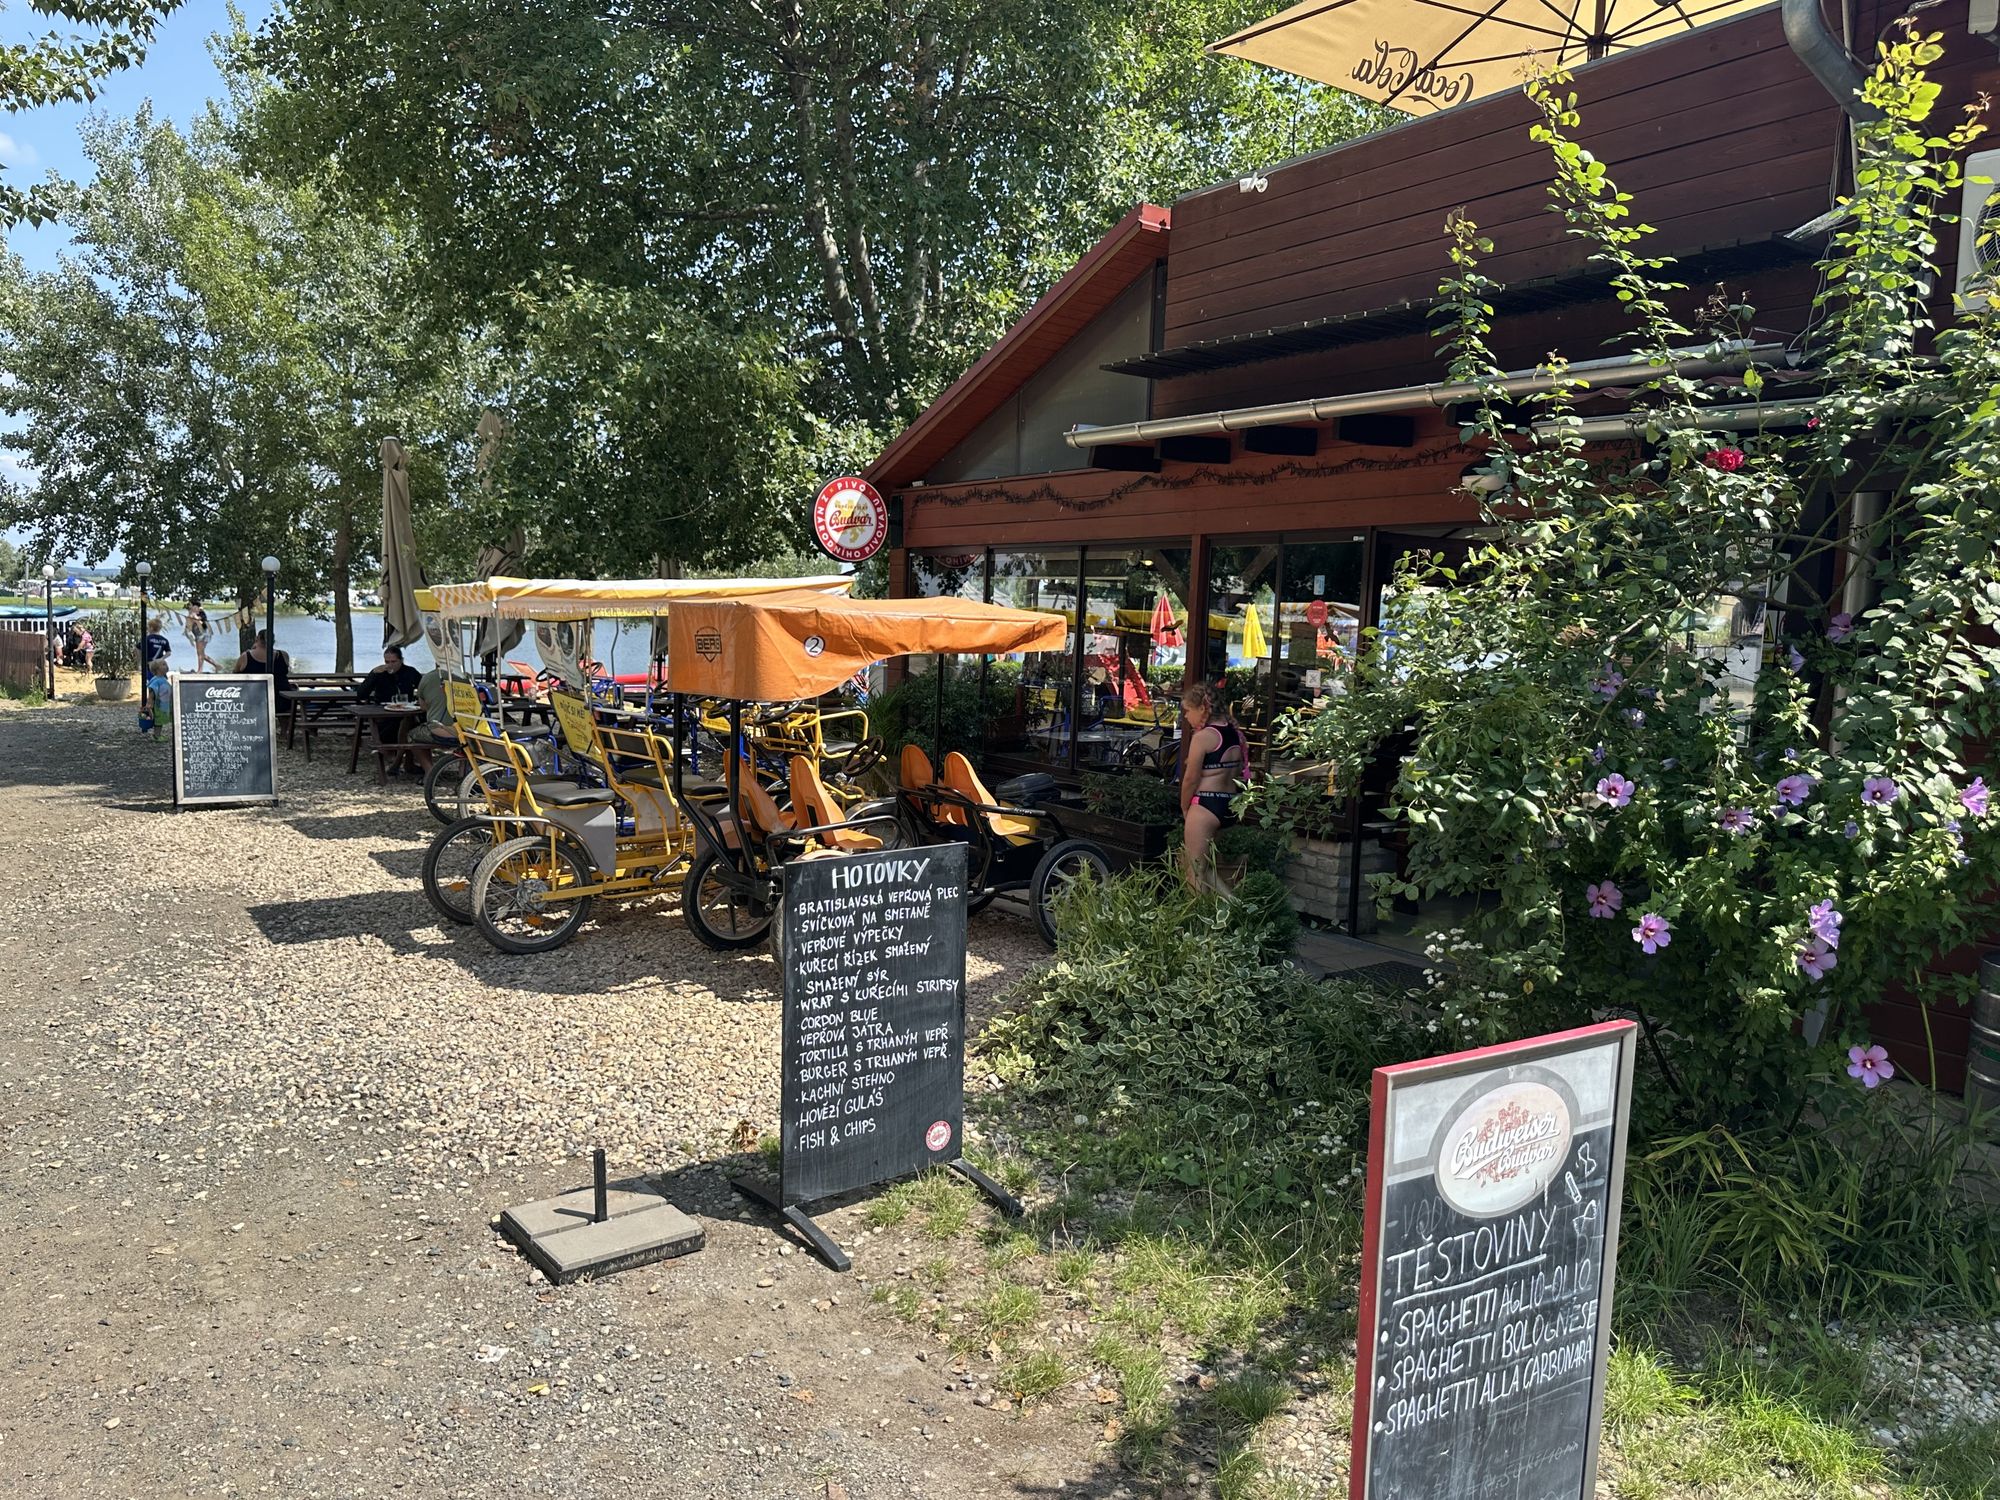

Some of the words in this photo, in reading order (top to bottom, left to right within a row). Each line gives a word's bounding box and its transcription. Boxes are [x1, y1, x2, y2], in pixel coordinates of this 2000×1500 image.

[837, 481, 866, 492] PIVO
[817, 506, 861, 558] NÁRODNÍHO
[864, 498, 884, 553] PIVOVARU
[829, 510, 873, 530] Budvar
[153, 644, 162, 660] 7
[809, 637, 819, 653] 2
[205, 687, 242, 698] Coca-Cola
[832, 858, 930, 889] HOTOVKY
[800, 889, 883, 915] BRATISLAVSKÁ
[889, 884, 932, 903] VEPŘOVÁ
[937, 887, 959, 900] PLEC
[802, 912, 855, 933] SVÍČKOVÁ
[863, 912, 876, 926] NA
[800, 950, 838, 975] KUŘECÍ
[844, 949, 877, 967] ŘÍZEK
[885, 935, 932, 959] SMAŽENÝ
[802, 931, 846, 955] VEPŘOVÉ
[854, 925, 903, 945] VÝPEČKY
[801, 995, 833, 1010] WRAP
[840, 992, 849, 1003] S
[855, 980, 908, 1001] KUŘECÍMI
[916, 979, 959, 997] STRIPSY
[806, 970, 861, 994] SMAŽENÝ
[867, 968, 889, 982] SÝR
[801, 1012, 843, 1030] CORDON
[850, 1008, 878, 1022] BLUE
[801, 1026, 846, 1046] VEPŘOVÁ
[852, 1020, 893, 1038] JÁTRA
[800, 1045, 848, 1064] TORTILLA
[856, 1042, 863, 1052] S
[867, 1029, 917, 1050] TRHANÝM
[800, 1062, 848, 1082] BURGER
[854, 1060, 861, 1072] S
[865, 1048, 917, 1069] TRHANÝM
[923, 1043, 951, 1060] VEPŘ.
[801, 1078, 846, 1103] KACHNÍ
[852, 1071, 894, 1090] STEHNO
[800, 1098, 840, 1128] HOVĚZÍ
[845, 1087, 884, 1115] GULÁŠ
[800, 1130, 824, 1152] FISH
[830, 1126, 840, 1145] &
[845, 1118, 876, 1136] CHIPS
[1450, 1112, 1561, 1178] Budweiser
[1498, 1143, 1557, 1173] Budvar
[1395, 1288, 1498, 1347] SPAGHETTI
[1389, 1332, 1496, 1391] SPAGHETTI
[1501, 1299, 1598, 1358] BOLOGNESE
[1385, 1377, 1478, 1435] SPAGHETTI
[1479, 1365, 1519, 1404] ALLA
[1523, 1335, 1593, 1389] CARBONARA
